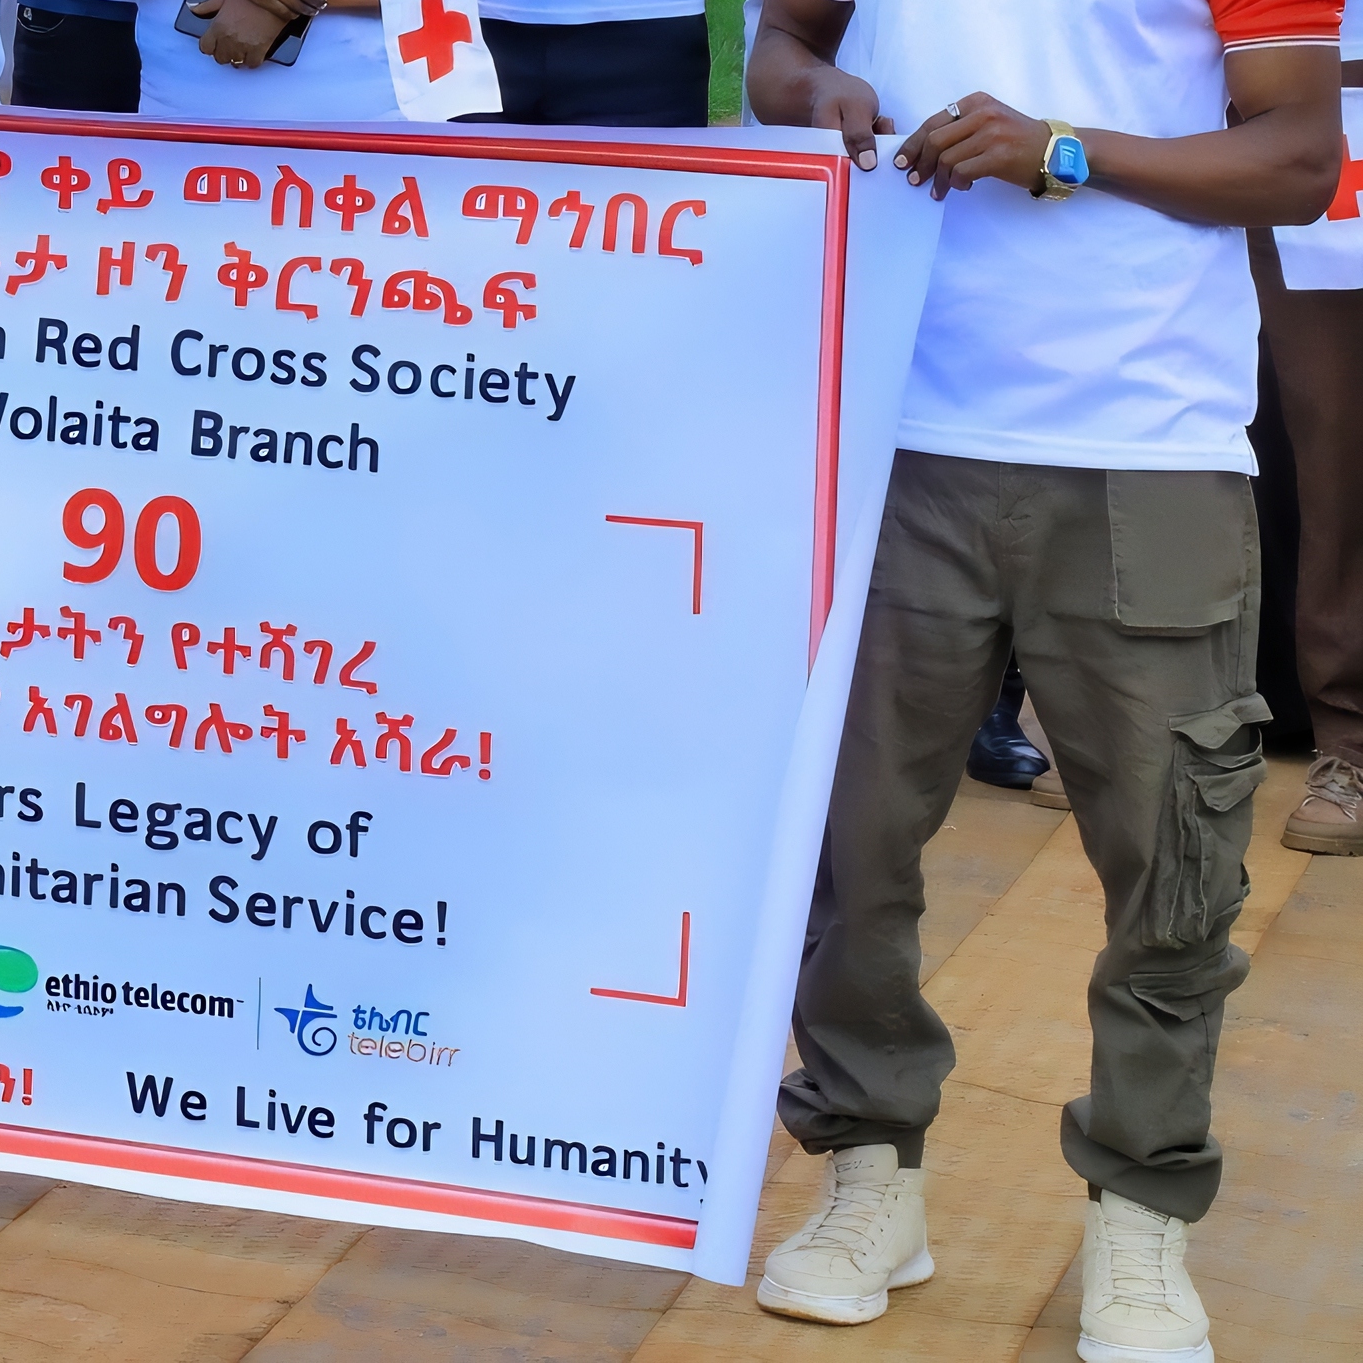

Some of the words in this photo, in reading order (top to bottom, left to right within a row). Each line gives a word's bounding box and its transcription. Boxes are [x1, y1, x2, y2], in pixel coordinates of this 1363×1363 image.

[40, 156, 154, 215] ቀይ
[183, 165, 429, 239] መስቀል
[462, 184, 706, 266] ማኅበር
[95, 240, 187, 302] ዞን
[217, 241, 537, 329] ቅርንጫፍ
[35, 317, 140, 372] Red
[170, 329, 328, 387] Cross
[350, 343, 576, 422] Society
[191, 409, 380, 473] Branch
[61, 488, 202, 592] 90
[171, 621, 378, 695] የተሻገረ
[23, 685, 307, 761] አገልግሎት
[330, 712, 492, 780] አሻራ!
[74, 781, 277, 861] Legacy
[306, 810, 373, 858] of
[208, 874, 448, 947] Service!
[45, 973, 117, 1004] ethio
[122, 981, 235, 1018] telecom
[347, 1031, 461, 1067] telebirr
[126, 1071, 208, 1121] We
[236, 1086, 335, 1138] Live
[363, 1102, 442, 1153] for
